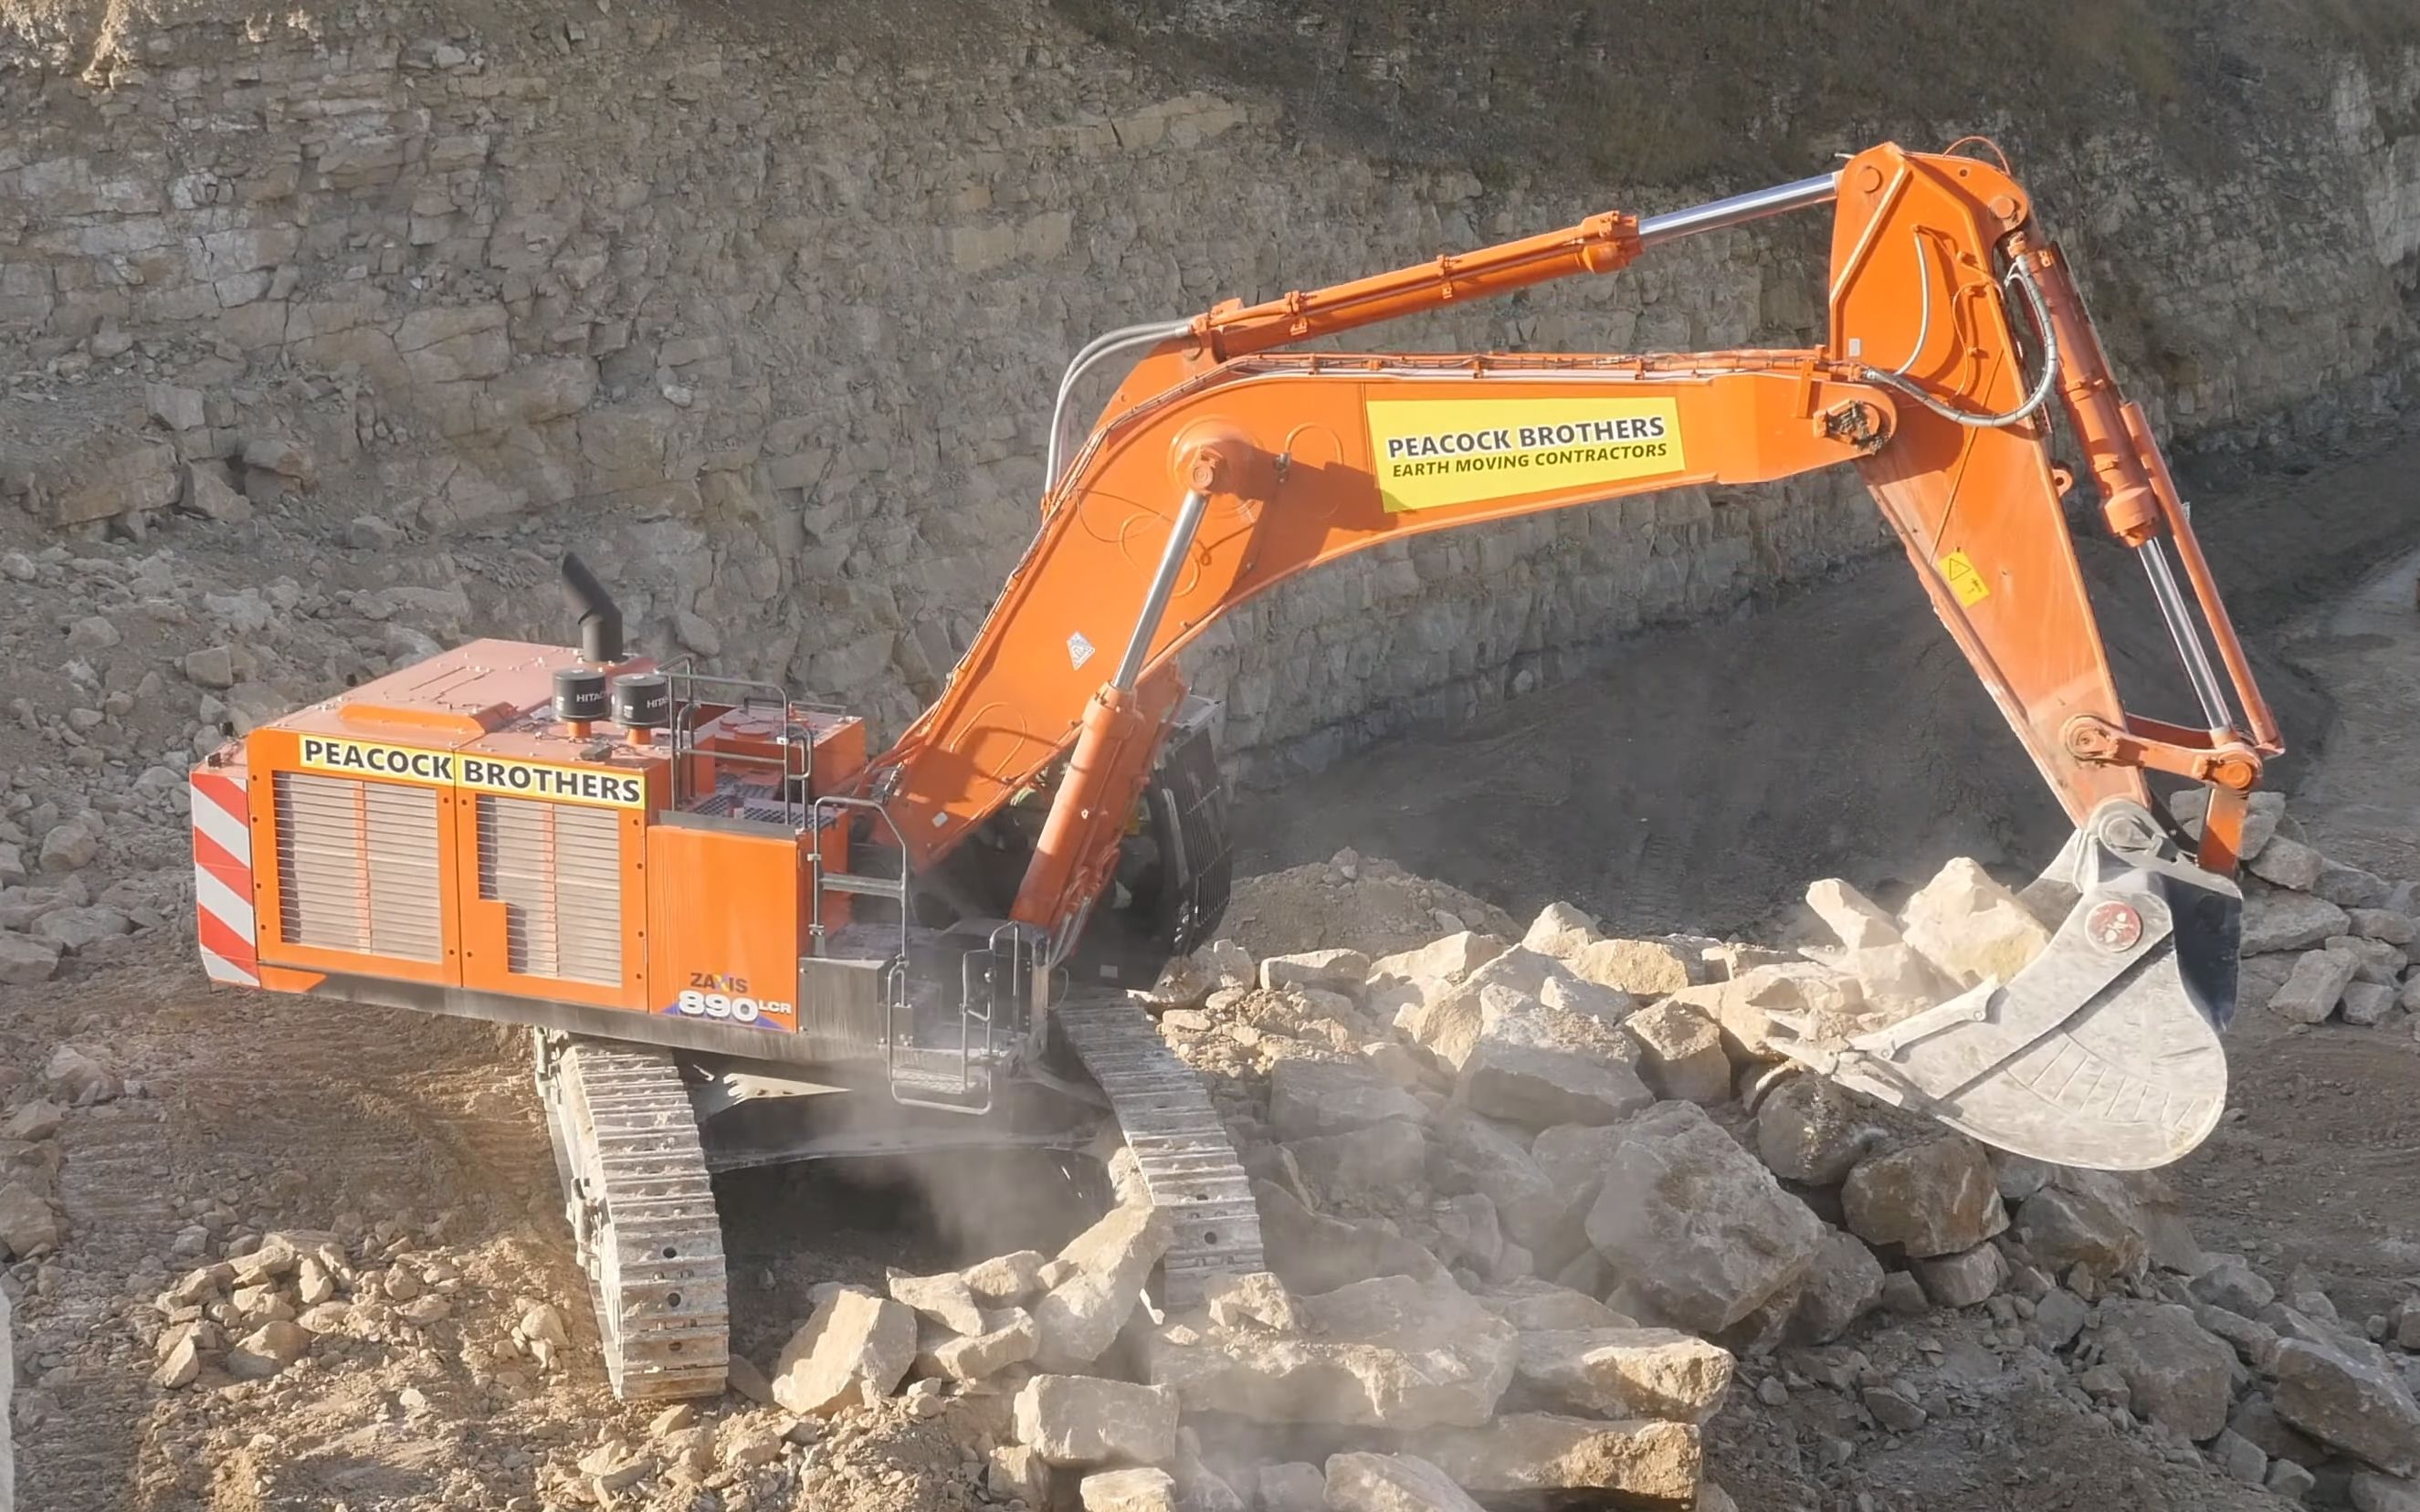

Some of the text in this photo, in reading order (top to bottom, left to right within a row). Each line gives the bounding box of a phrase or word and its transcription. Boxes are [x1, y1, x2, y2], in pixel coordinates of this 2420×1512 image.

[1388, 416, 1665, 457] PEACOCK BROTHERS
[1393, 443, 1668, 478] EARTH MOVING CONTRACTORS
[305, 740, 640, 803] PEACOCK BROTHERS
[690, 972, 747, 992] ZAXIS
